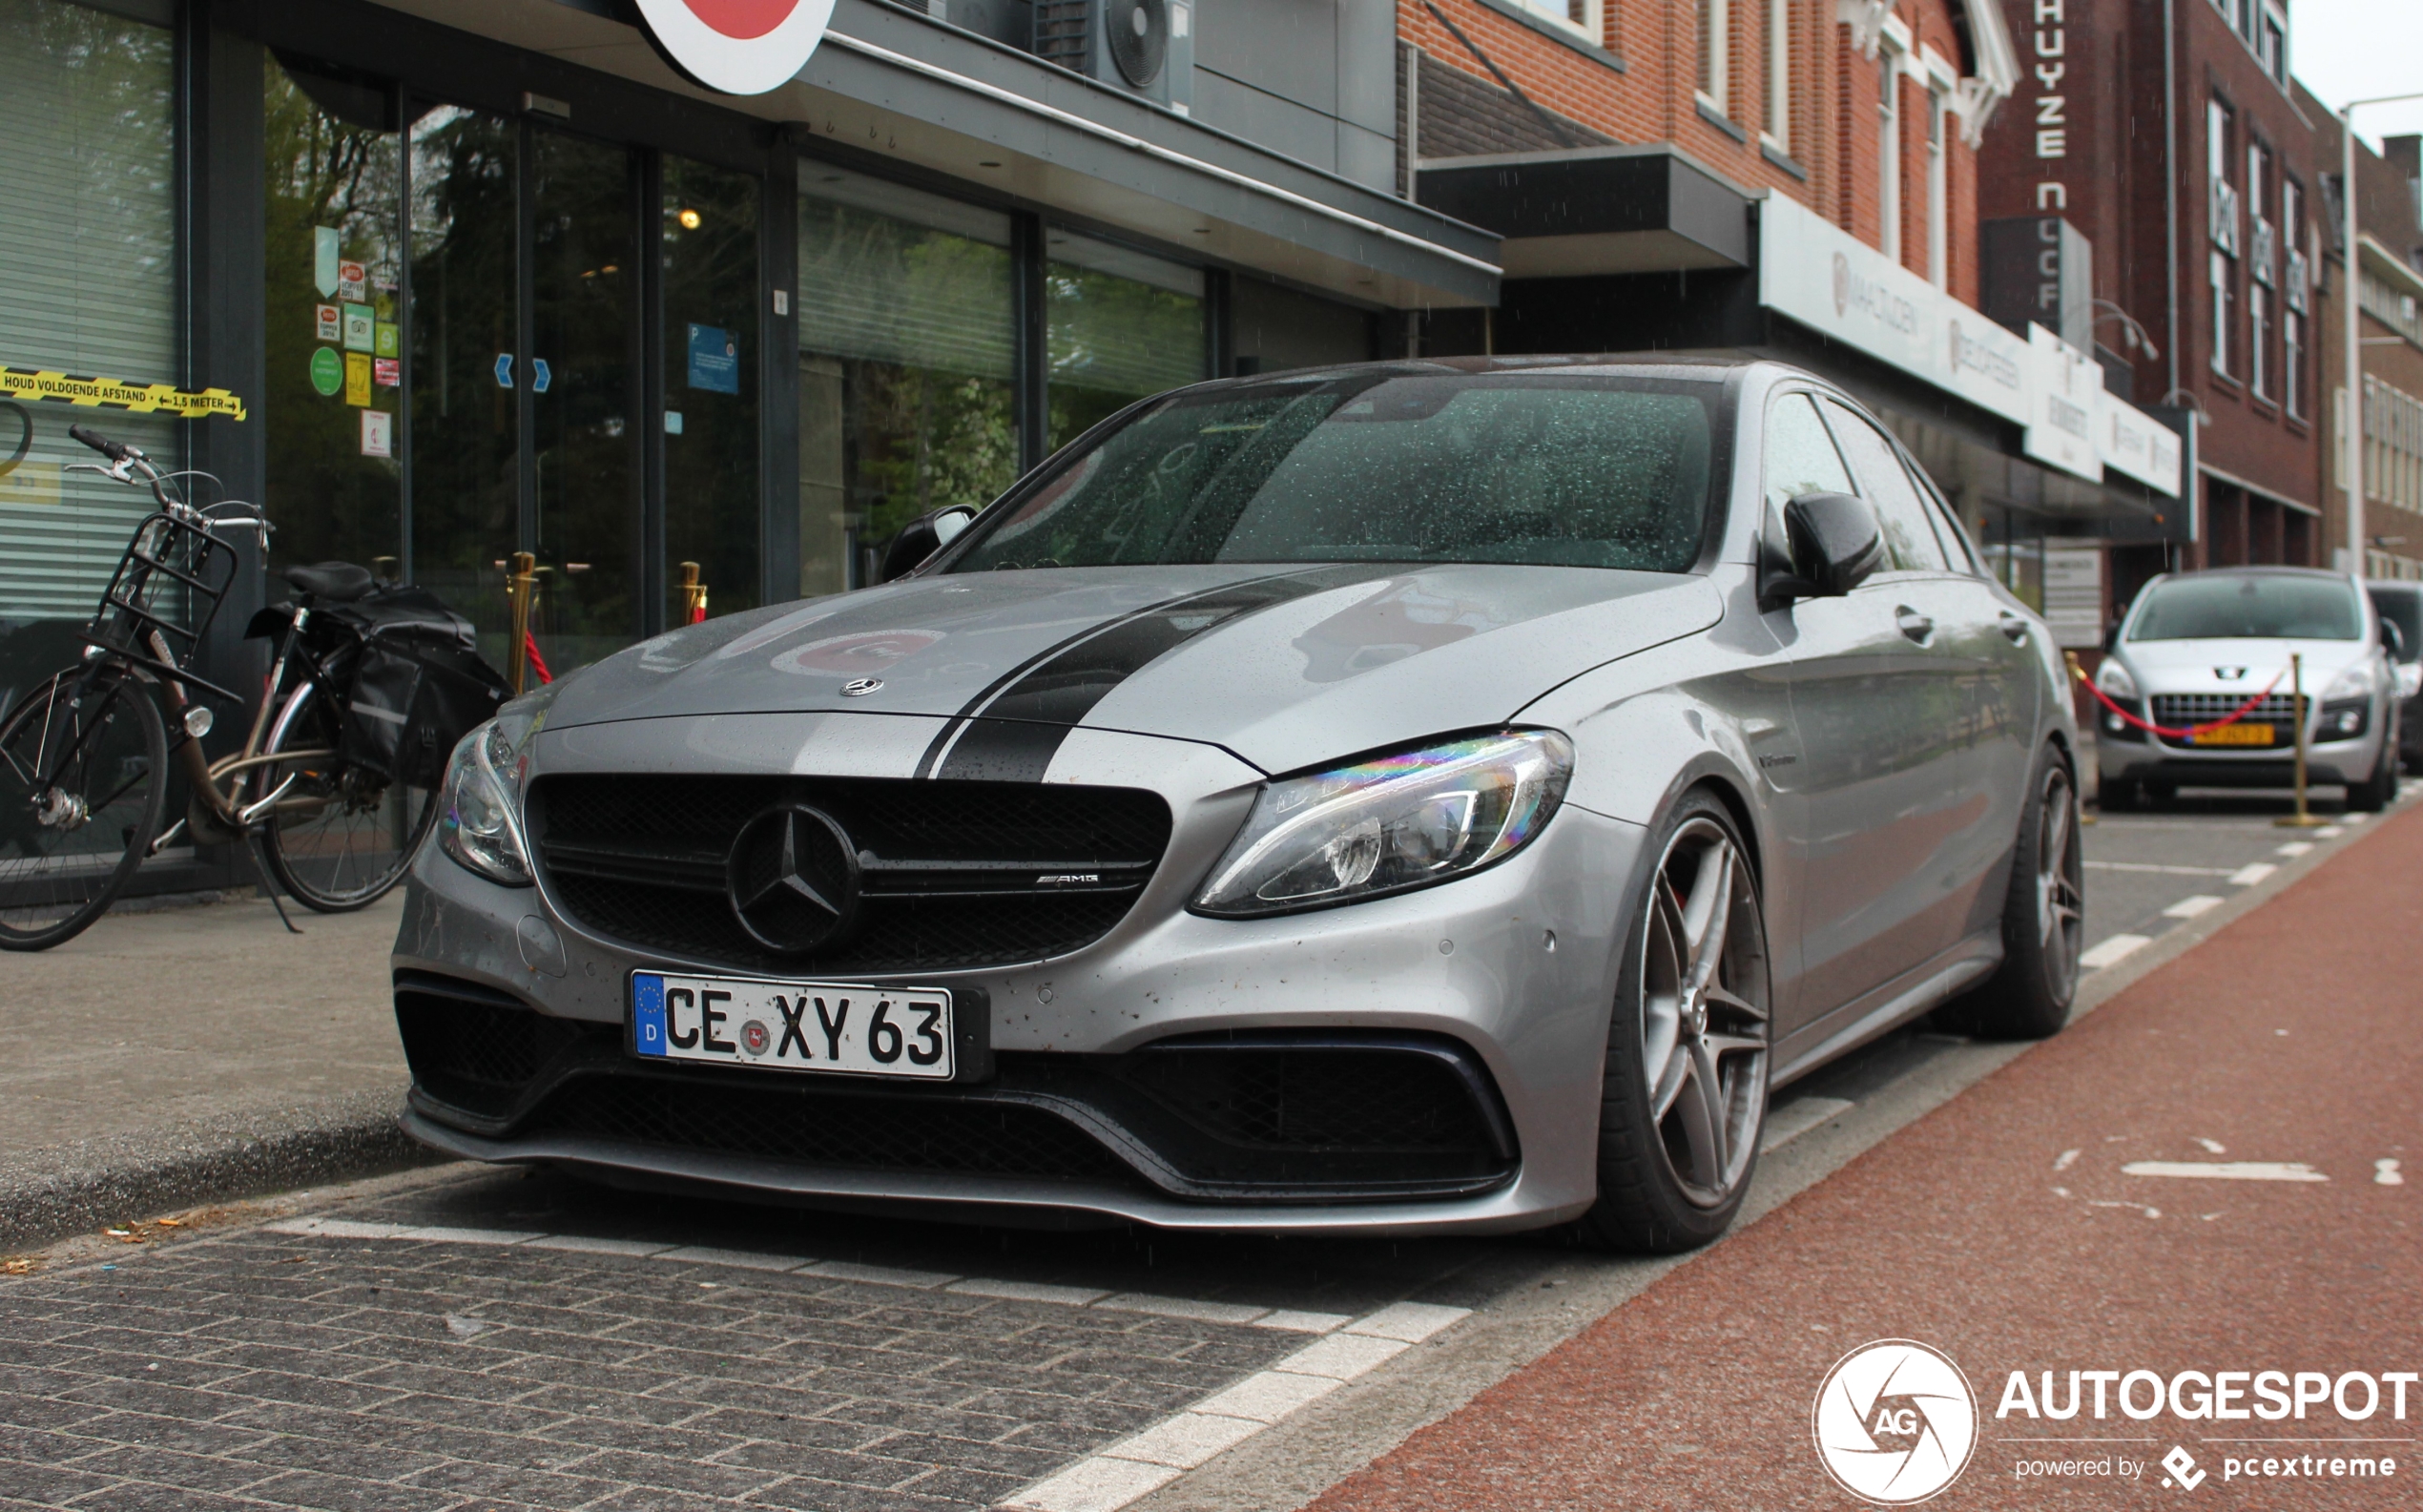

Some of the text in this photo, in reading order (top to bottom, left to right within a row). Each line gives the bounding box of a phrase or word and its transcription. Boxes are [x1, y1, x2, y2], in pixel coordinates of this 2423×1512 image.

[2035, 0, 2065, 158] HUYZE
[5, 376, 224, 408] HOUD VOLDOENDE AFSTAND 1,5 METER
[646, 1024, 656, 1042] D
[666, 988, 942, 1066] CE XY 63
